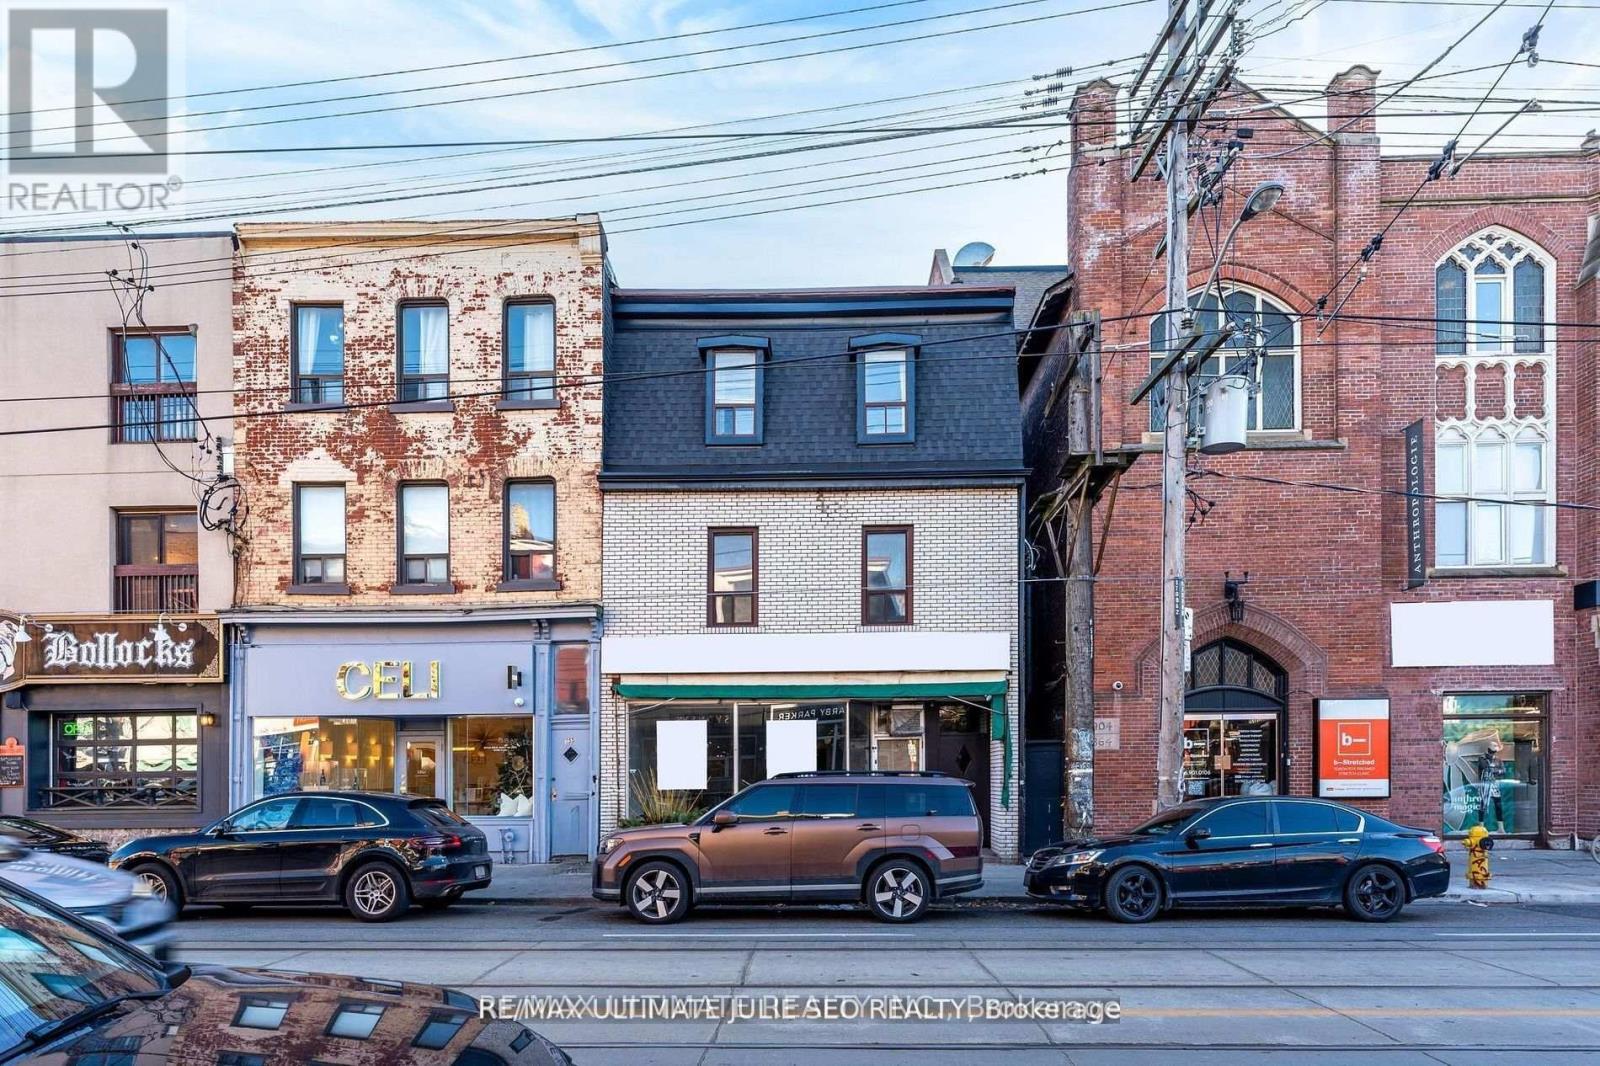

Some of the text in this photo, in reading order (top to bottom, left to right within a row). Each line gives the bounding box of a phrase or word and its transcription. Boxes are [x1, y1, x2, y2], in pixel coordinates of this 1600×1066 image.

[1410, 435, 1421, 573] ANTHROPOLOGIE
[41, 629, 196, 669] Bollocks
[336, 660, 440, 700] CELI
